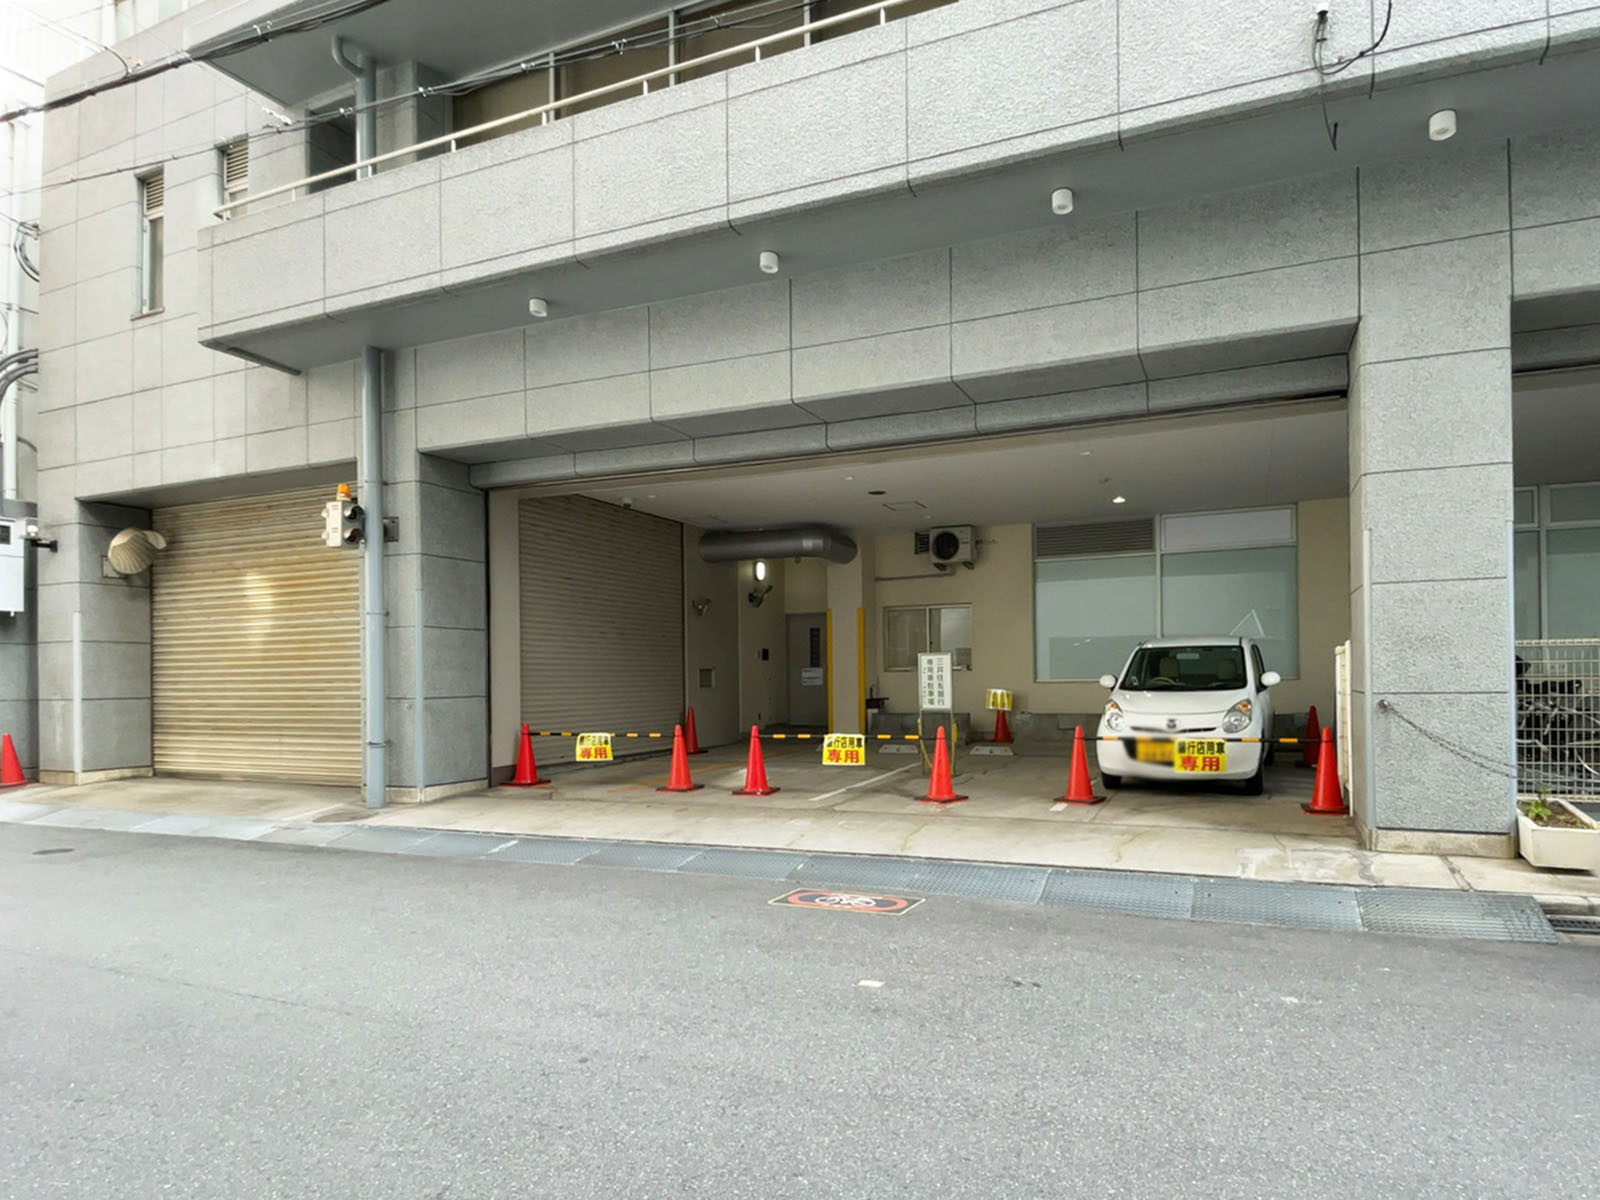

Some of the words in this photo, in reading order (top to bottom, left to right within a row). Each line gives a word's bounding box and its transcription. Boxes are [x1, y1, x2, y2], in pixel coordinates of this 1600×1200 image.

[580, 747, 608, 759] 専用
[827, 749, 860, 763] 専用
[1180, 755, 1220, 771] 専用
